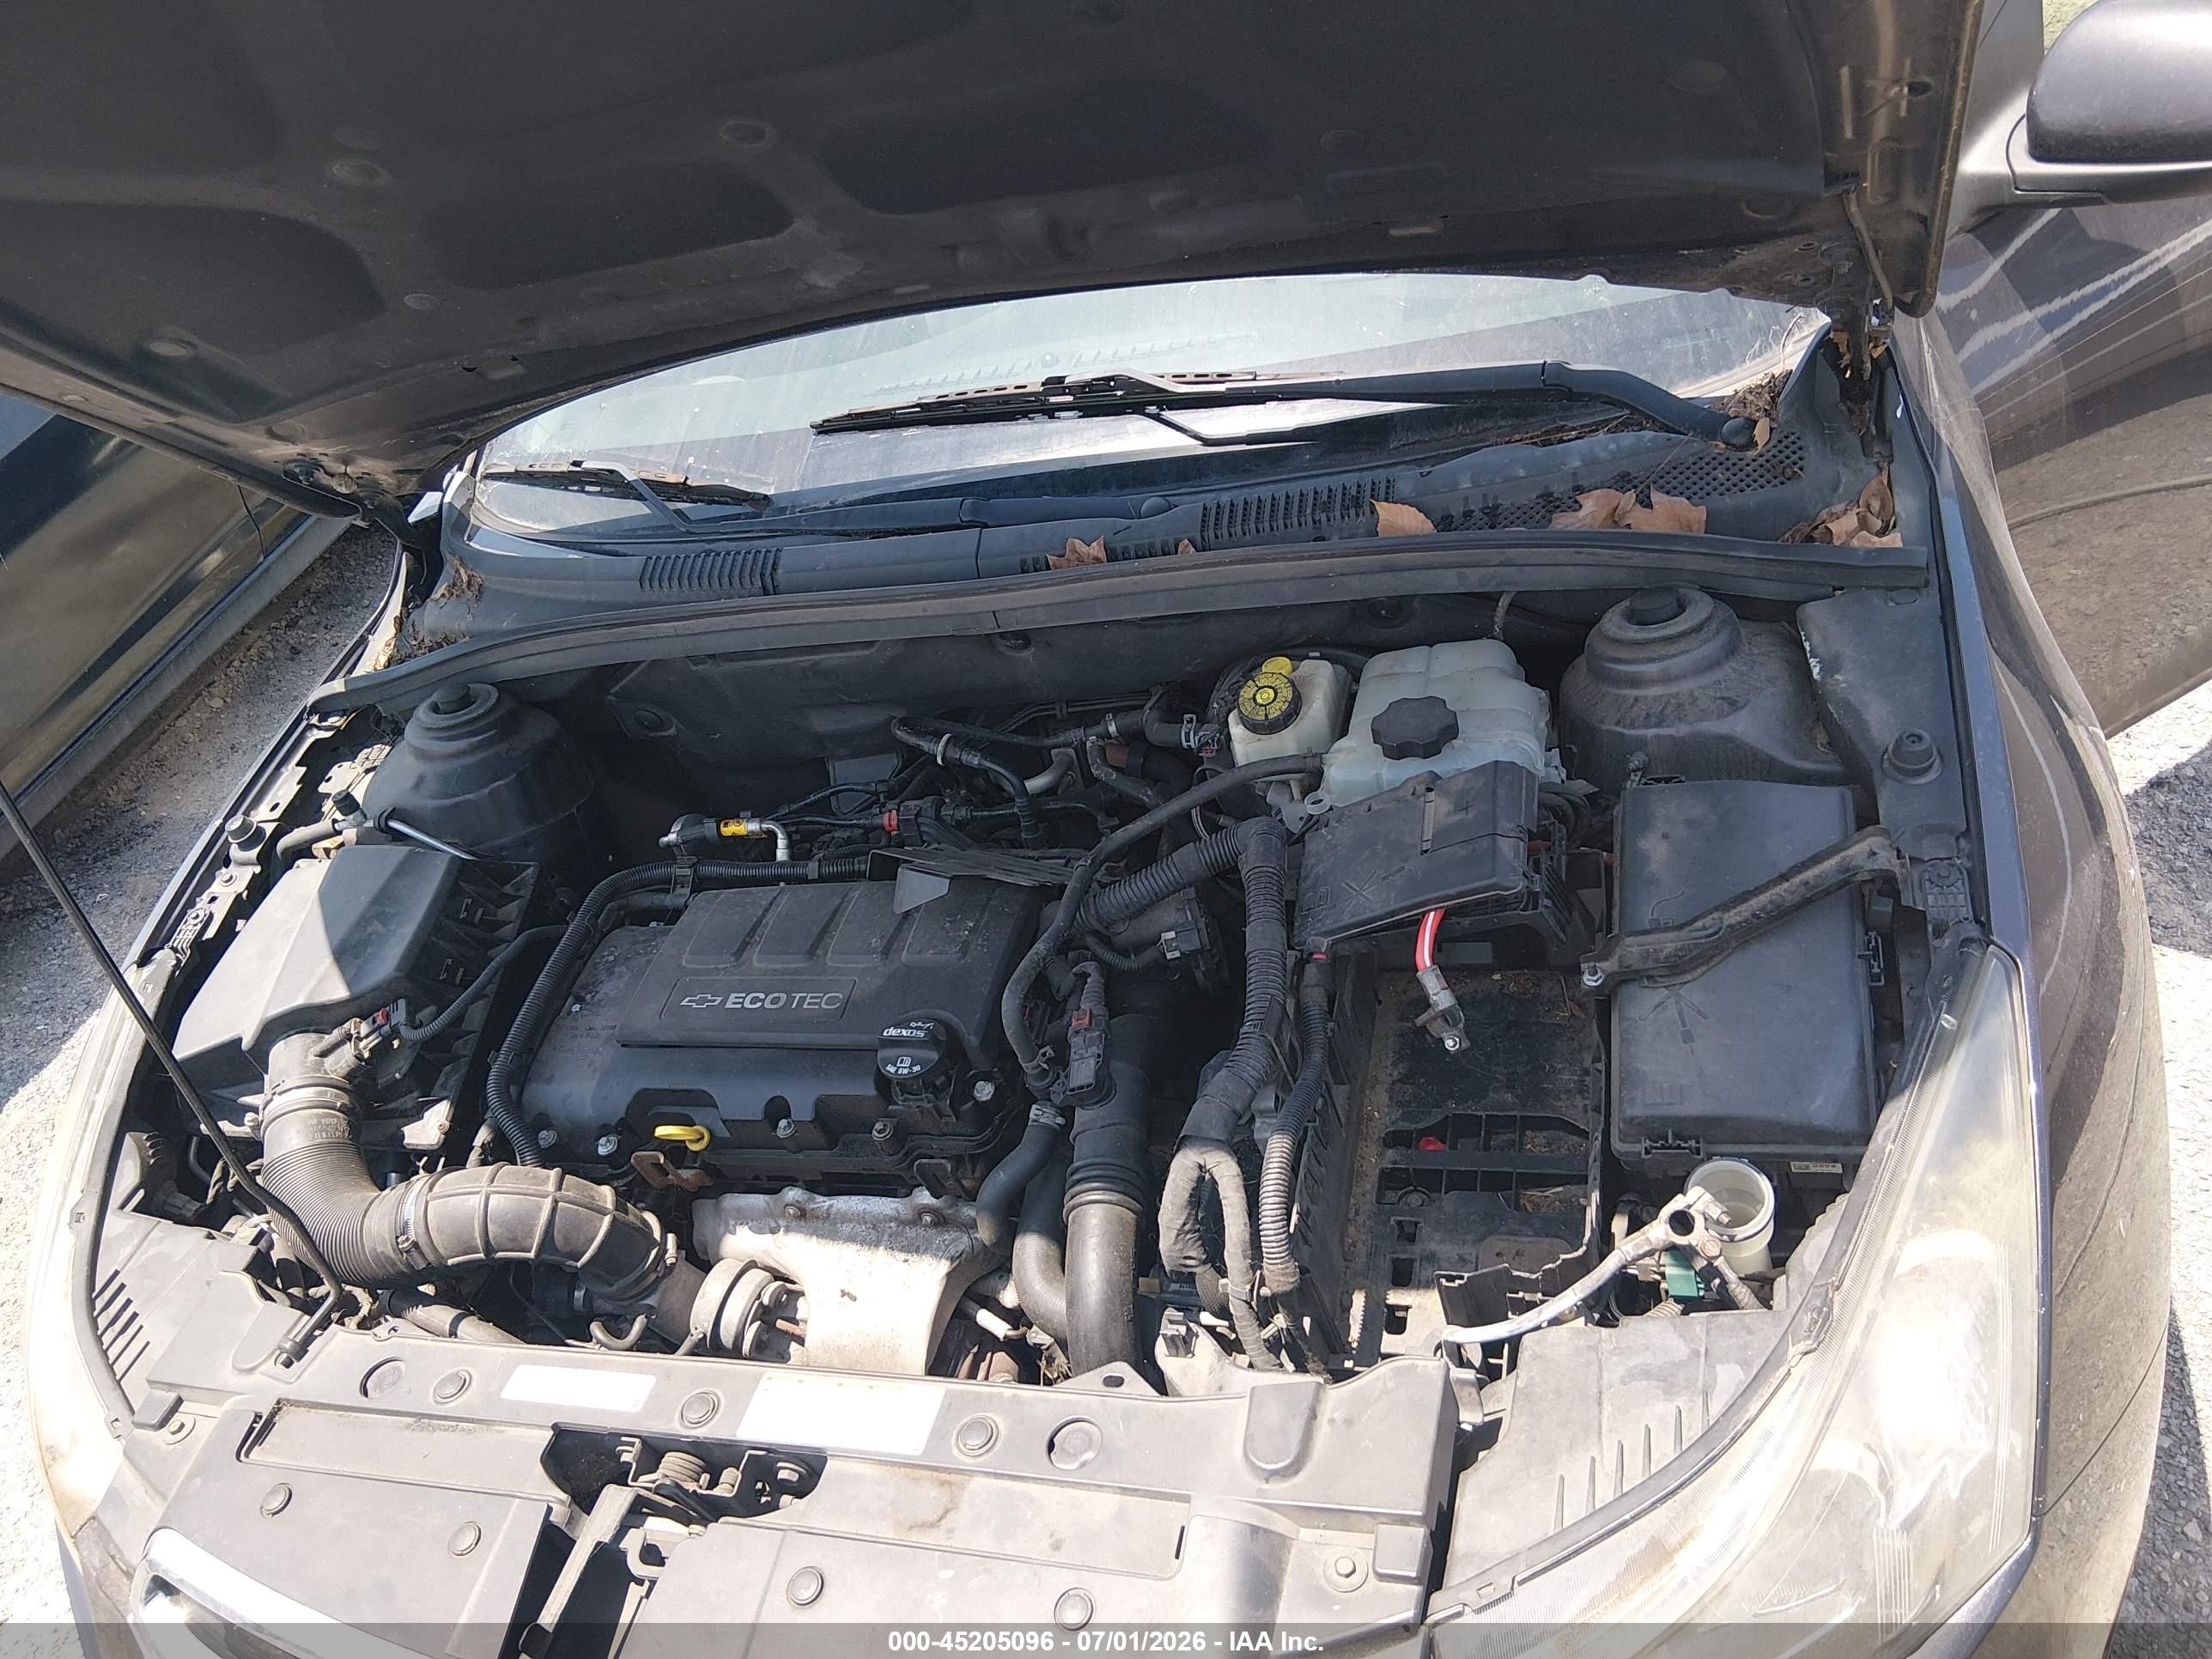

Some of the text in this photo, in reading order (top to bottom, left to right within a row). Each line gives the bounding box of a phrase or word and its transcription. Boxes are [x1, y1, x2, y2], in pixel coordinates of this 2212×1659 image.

[725, 993, 842, 1009] ECOTEC
[883, 1026, 928, 1037] dexos
[885, 1064, 897, 1073] SAE
